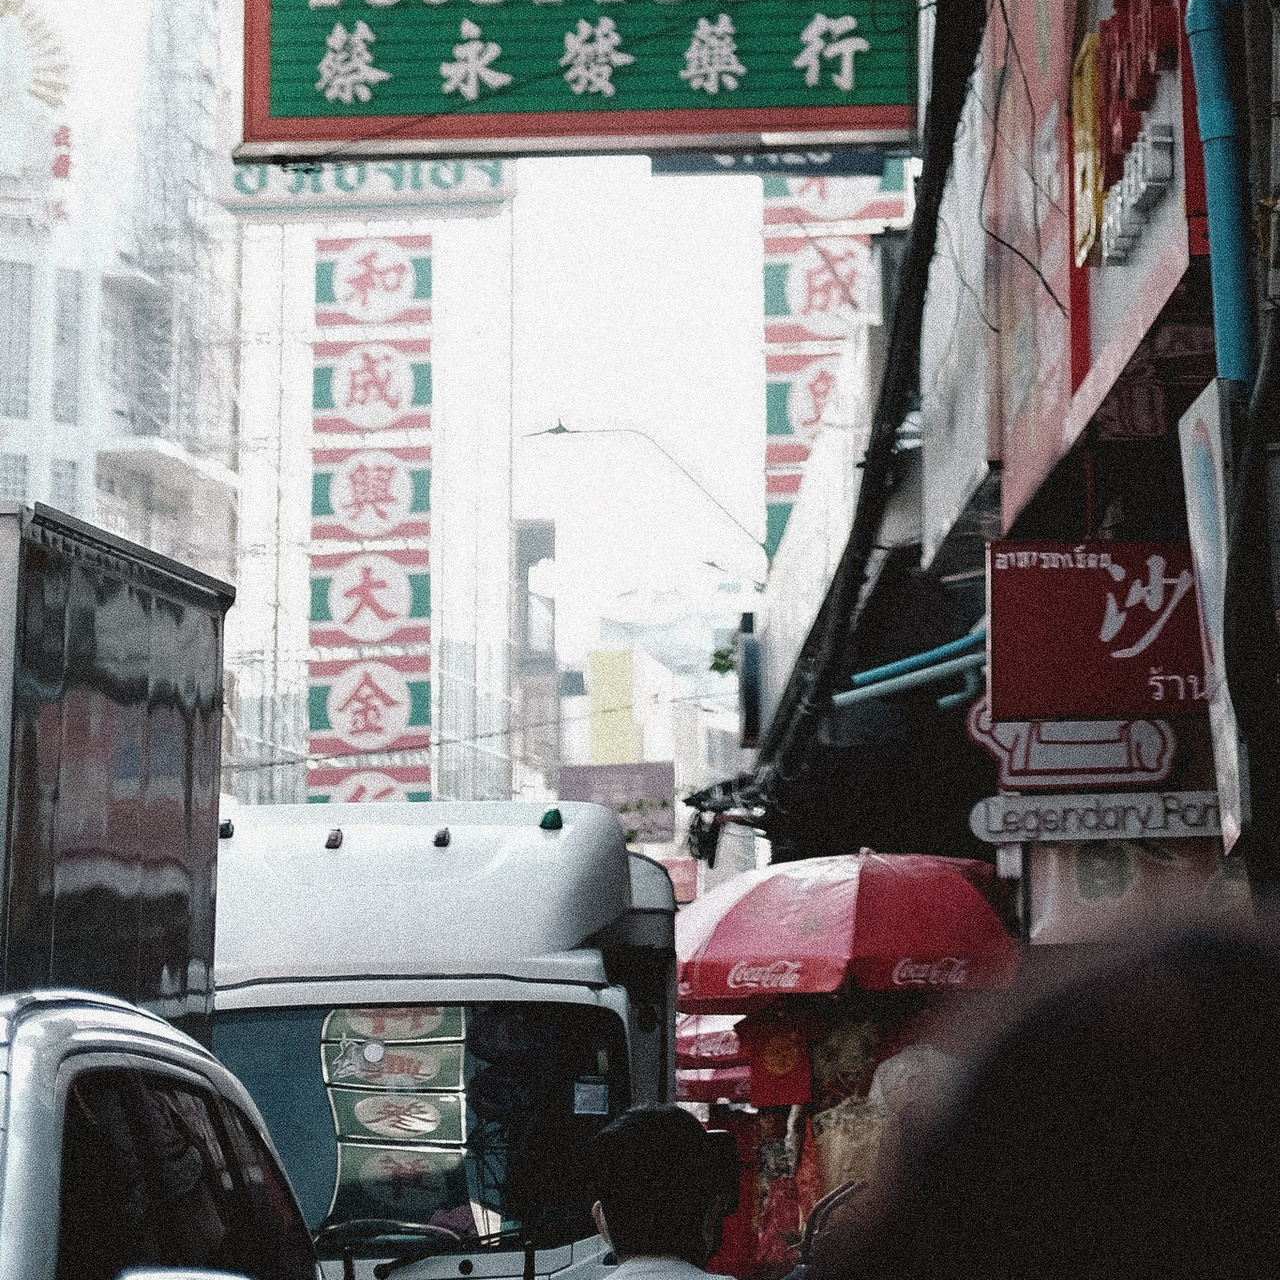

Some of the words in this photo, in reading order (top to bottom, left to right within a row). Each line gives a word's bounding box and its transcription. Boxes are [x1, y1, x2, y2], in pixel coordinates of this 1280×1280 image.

[315, 13, 872, 105] 蔡永發藥行
[337, 249, 406, 802] 和成興大金
